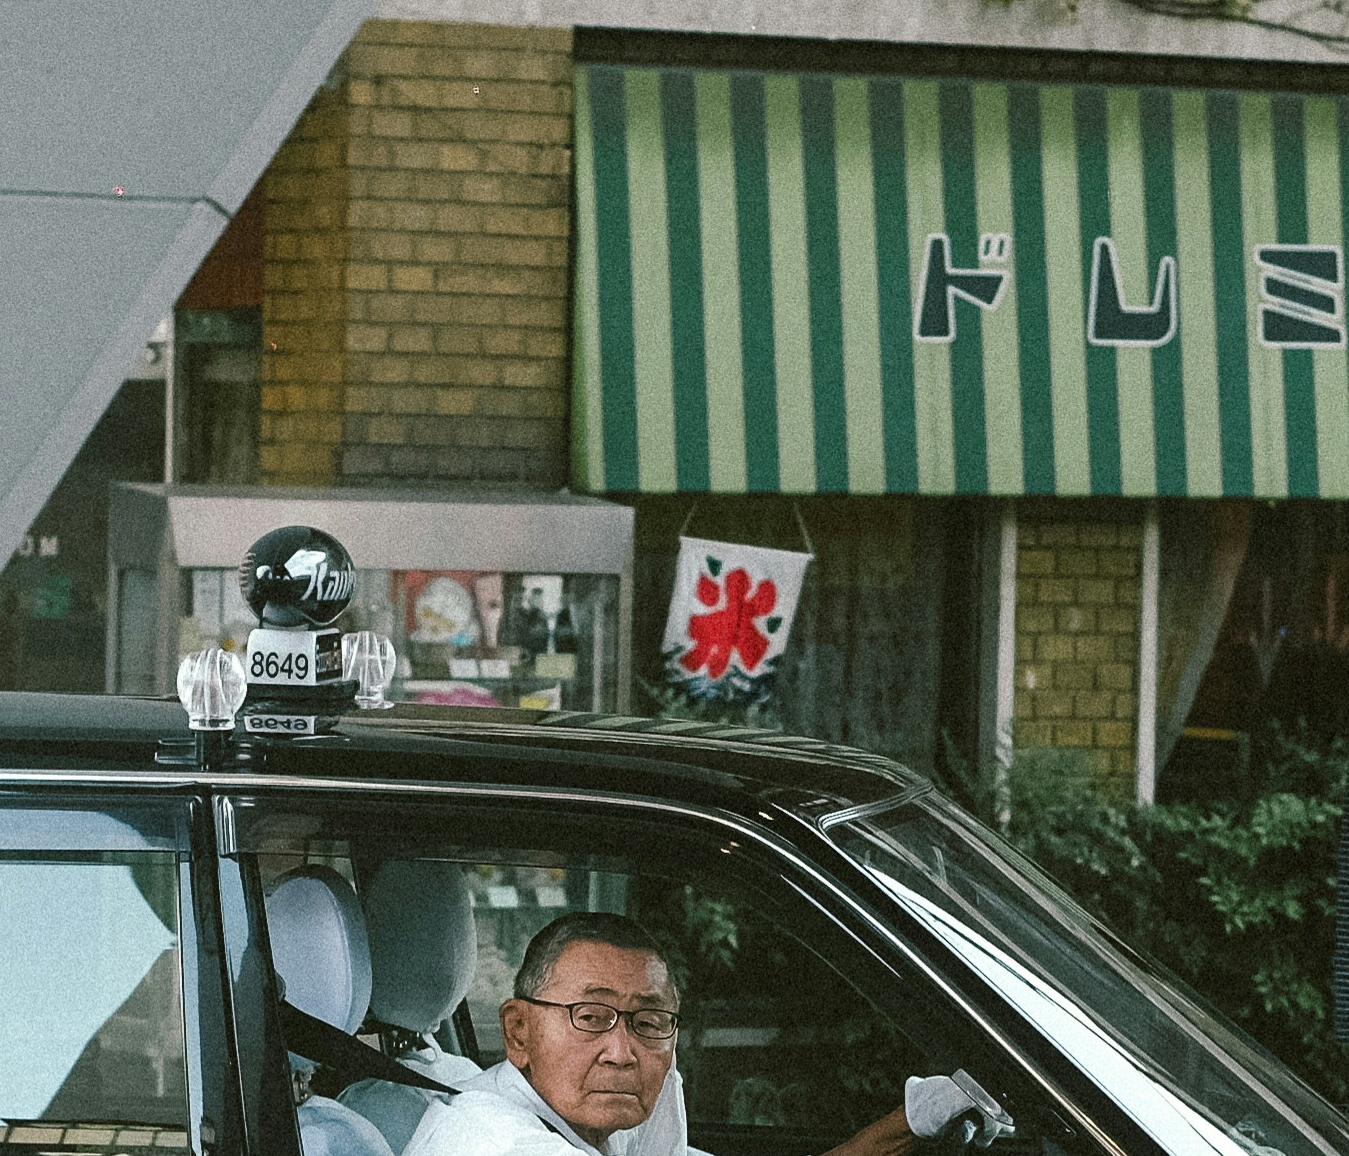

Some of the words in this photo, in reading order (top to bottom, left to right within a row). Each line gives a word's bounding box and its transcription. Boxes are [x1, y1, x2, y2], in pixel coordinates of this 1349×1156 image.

[915, 232, 1347, 348] ドレミ
[250, 651, 309, 680] 8649
